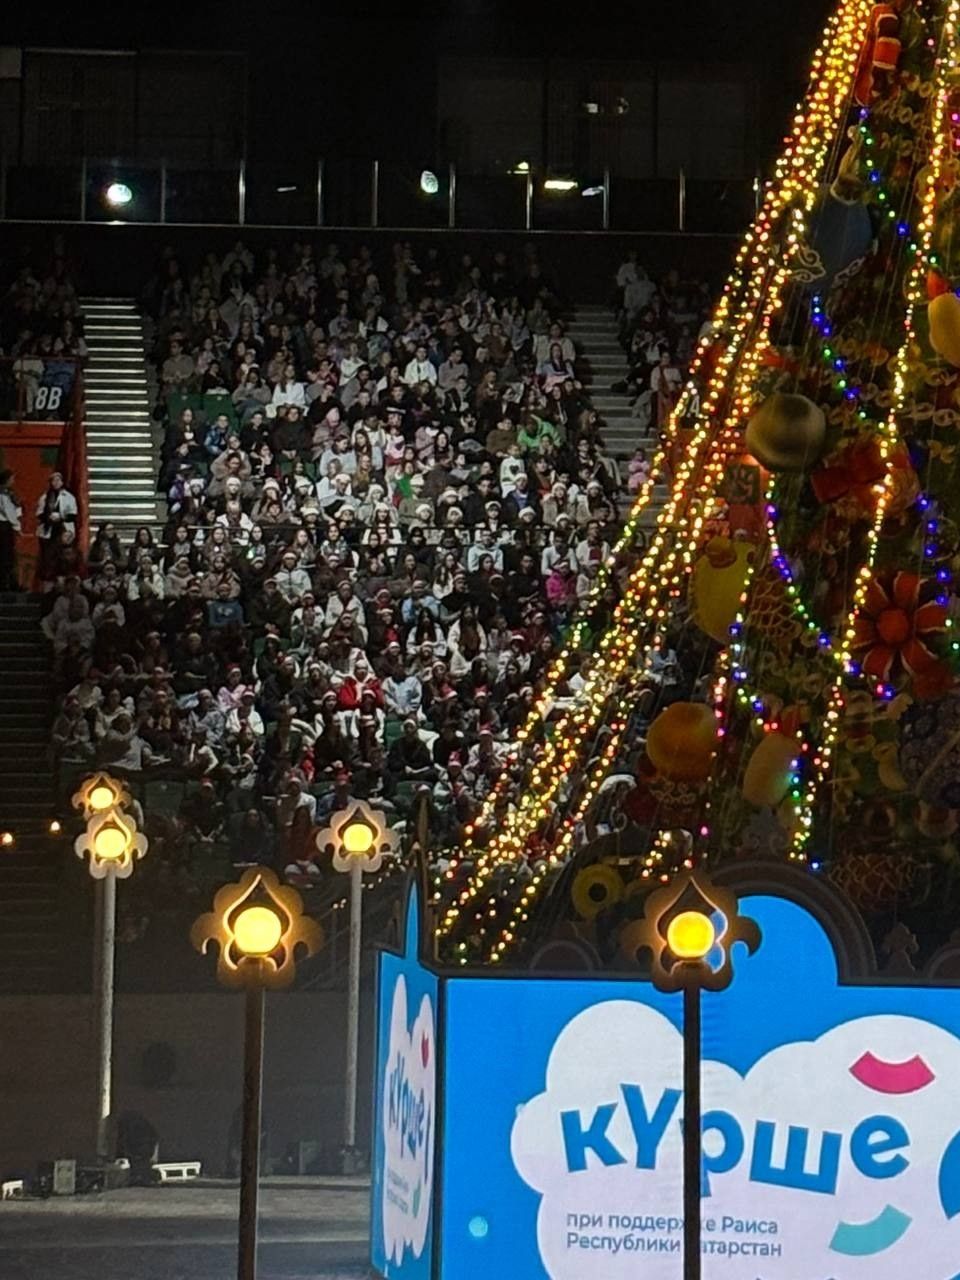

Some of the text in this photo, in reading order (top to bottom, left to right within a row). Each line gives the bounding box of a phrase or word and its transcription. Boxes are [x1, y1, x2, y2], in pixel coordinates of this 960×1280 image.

[34, 386, 62, 410] 8B
[566, 1213, 778, 1234] при поддере Раиса
[566, 1231, 782, 1259] Республики тарстан
